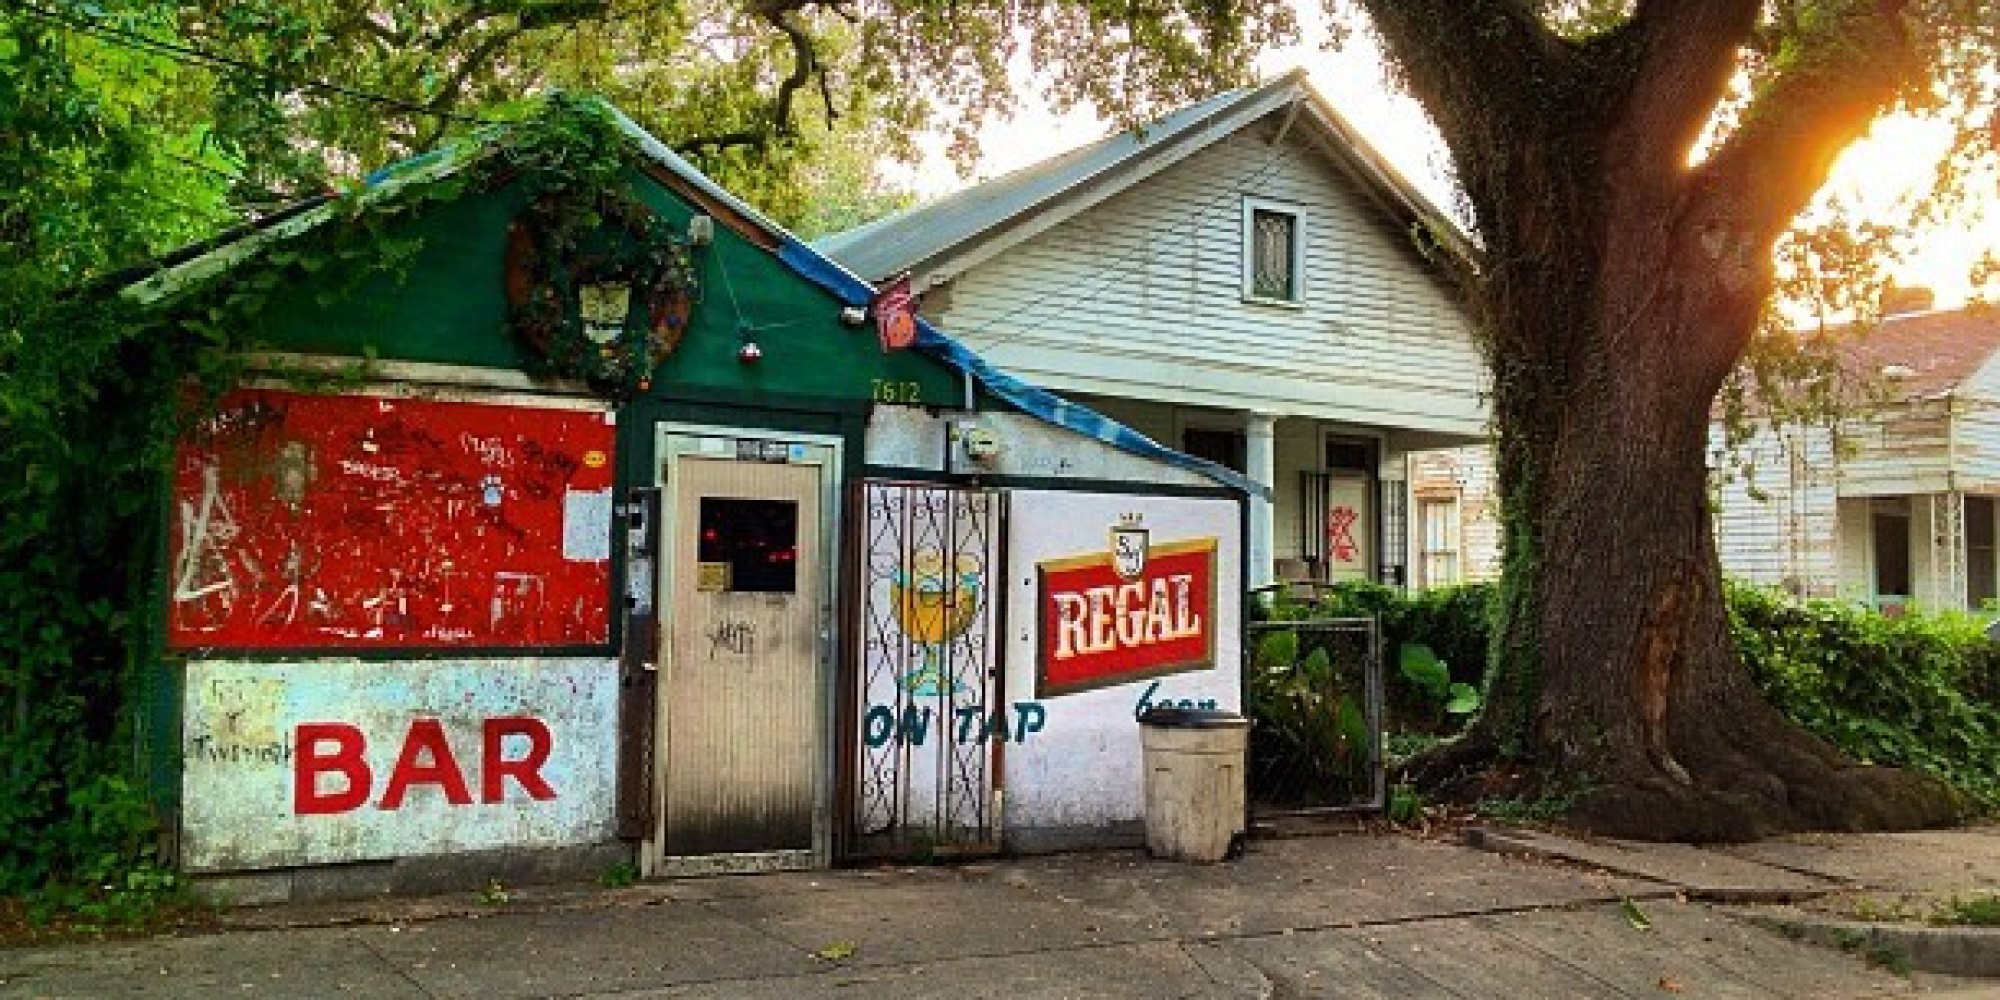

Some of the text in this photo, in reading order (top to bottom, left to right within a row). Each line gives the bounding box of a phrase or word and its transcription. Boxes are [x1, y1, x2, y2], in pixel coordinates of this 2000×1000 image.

[871, 379, 920, 402] 7612
[1053, 573, 1201, 660] REGAL
[864, 702, 1045, 748] ON TAP
[294, 716, 557, 815] BAR
